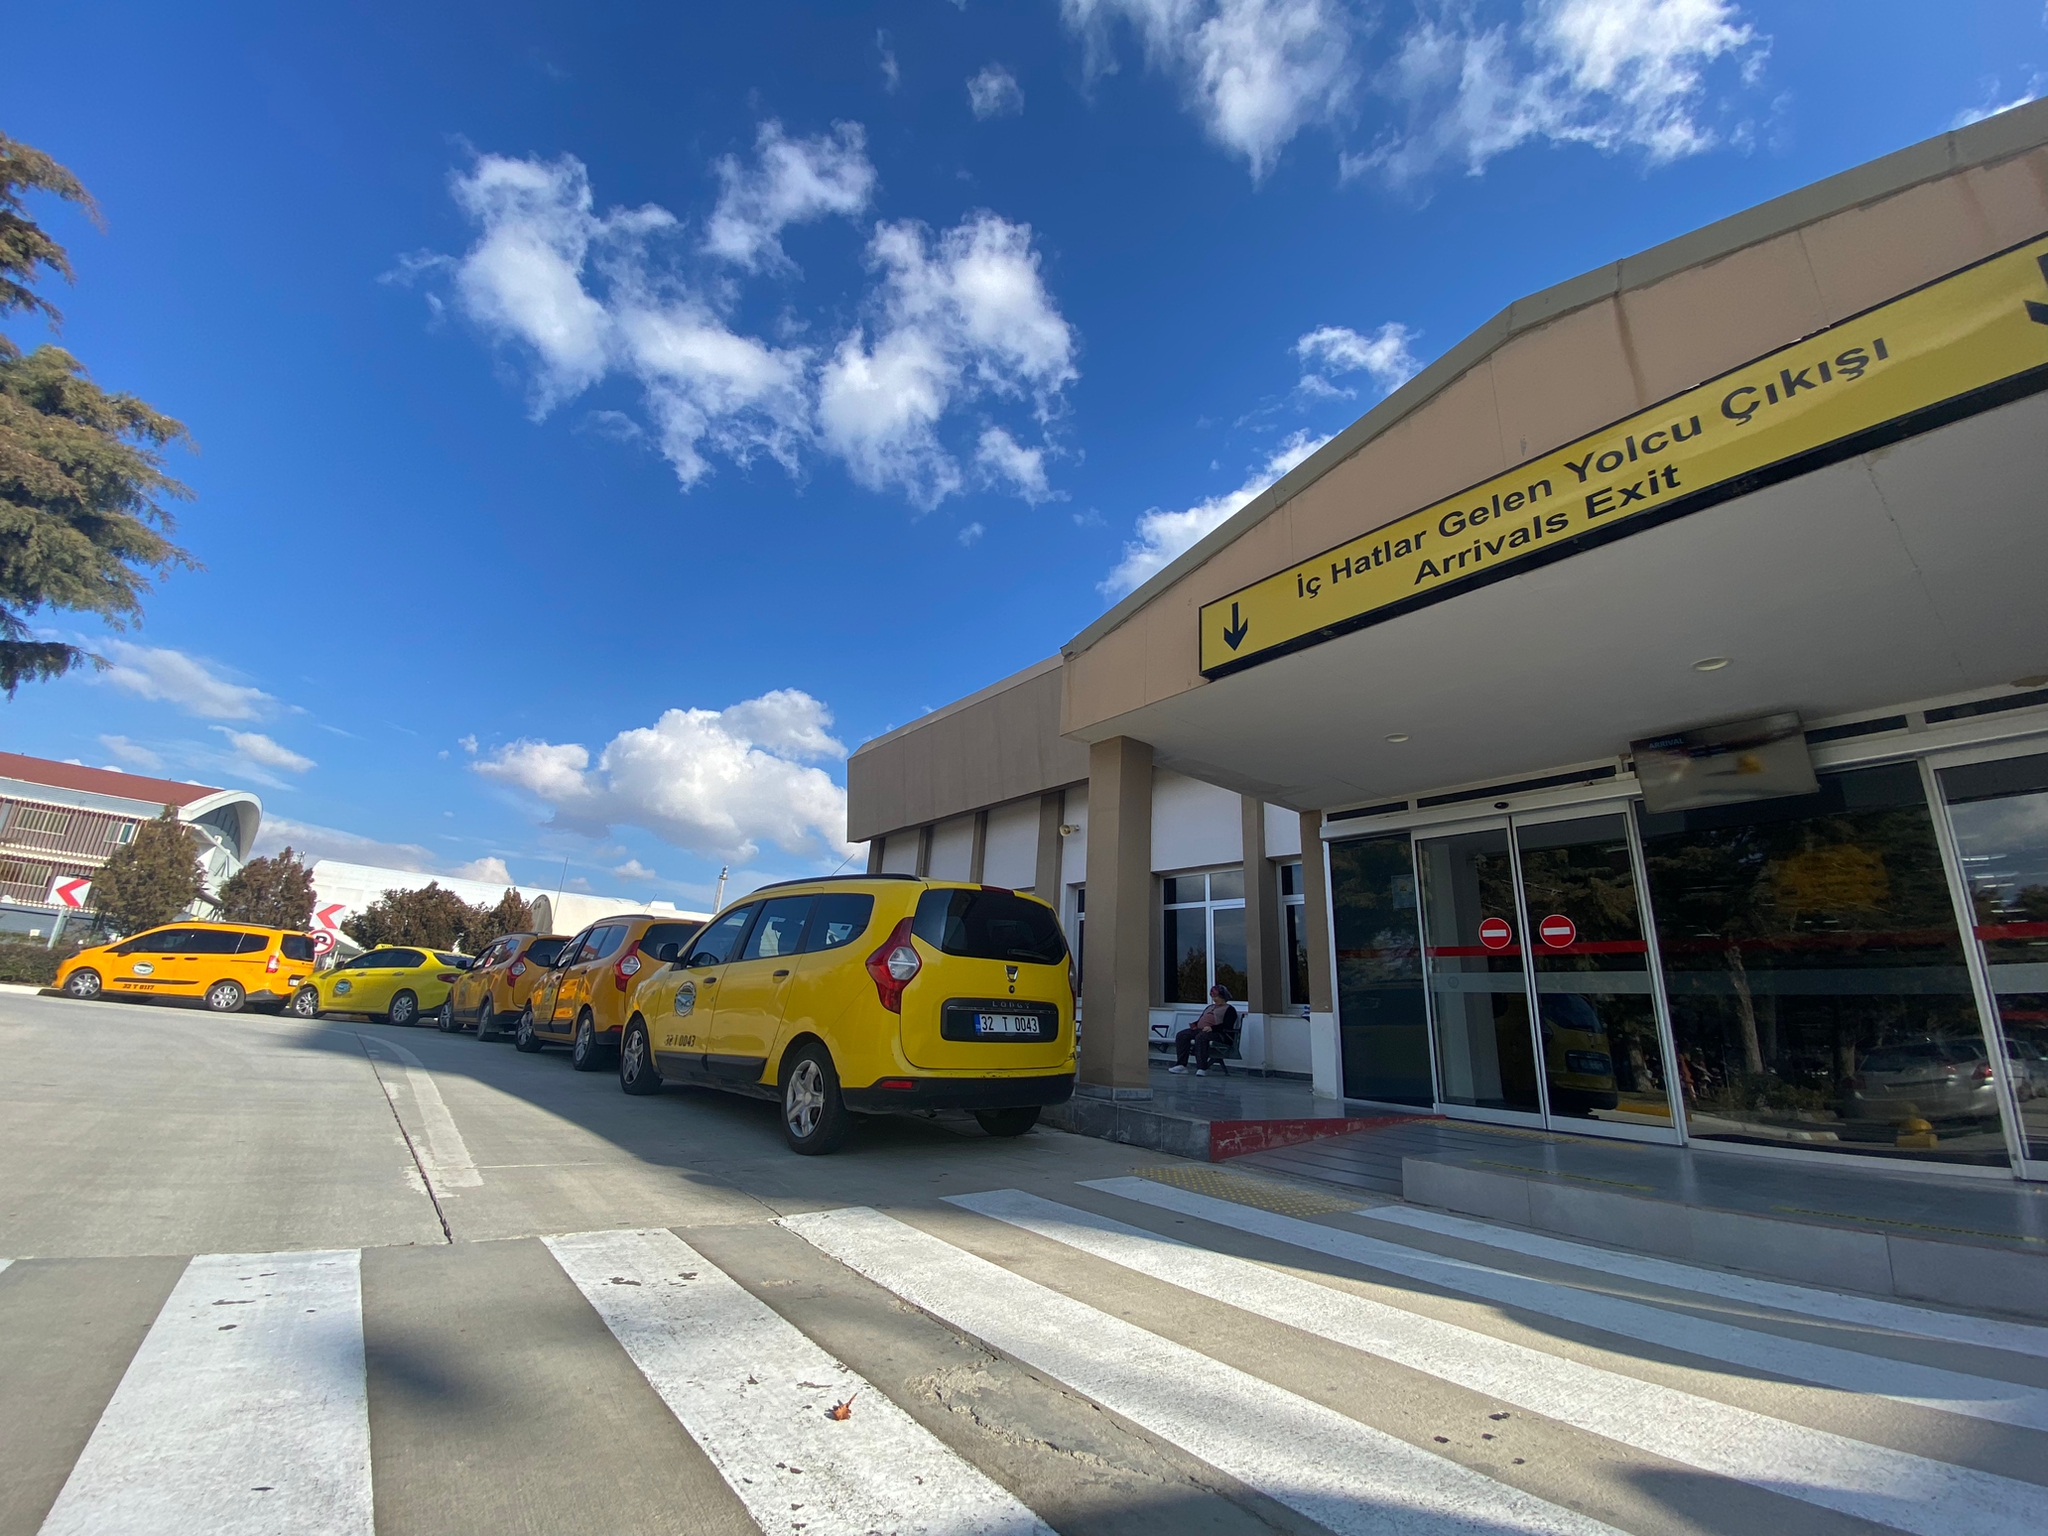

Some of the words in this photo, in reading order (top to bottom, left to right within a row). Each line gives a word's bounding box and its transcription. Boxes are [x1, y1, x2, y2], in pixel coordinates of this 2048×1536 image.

[1297, 573, 1322, 599] İç
[1331, 530, 1427, 584] Hatlar
[1438, 480, 1552, 538] Gelen
[1564, 415, 1703, 483] Yolcu
[1721, 337, 1889, 427] Çıkışı
[1414, 512, 1569, 586] Arrivals
[1585, 464, 1681, 519] Exit
[1649, 738, 1684, 749] ARRIVAL
[992, 1001, 1030, 1009] LODGY
[981, 1016, 994, 1031] 32
[1002, 1016, 1008, 1031] T
[1015, 1017, 1037, 1032] 0043
